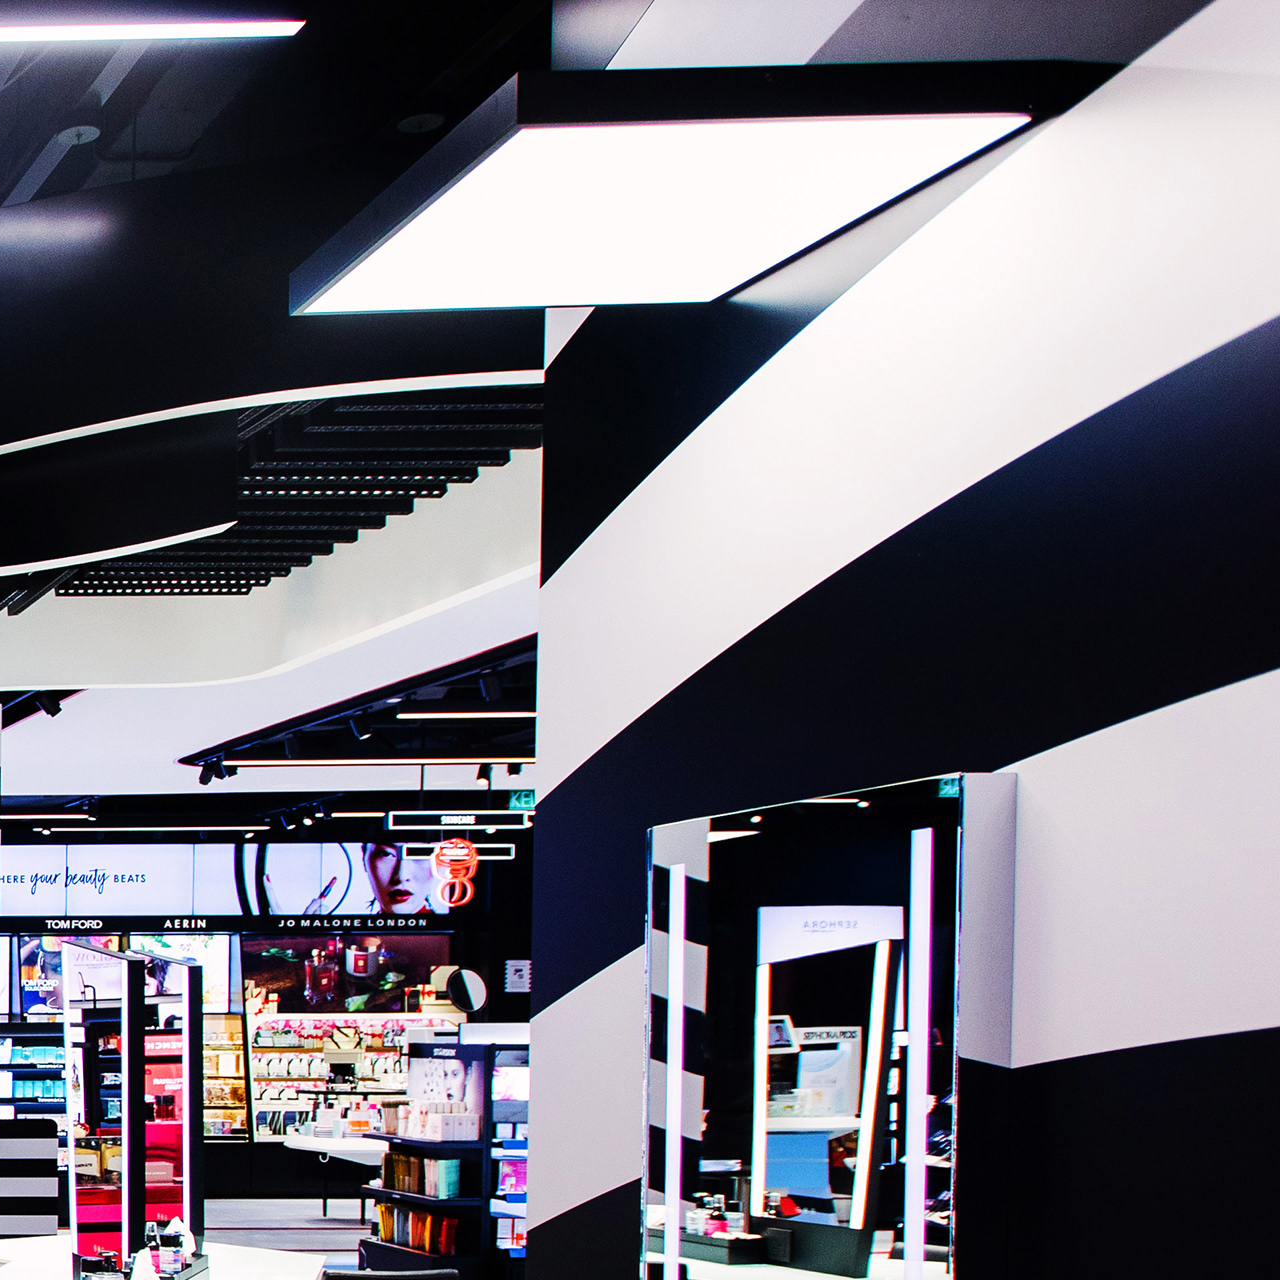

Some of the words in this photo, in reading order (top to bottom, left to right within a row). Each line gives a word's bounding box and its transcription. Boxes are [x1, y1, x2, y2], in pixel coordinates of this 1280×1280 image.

[30, 871, 61, 895] your
[64, 866, 110, 895] beauty
[114, 874, 146, 883] BEATS
[46, 919, 71, 929] TOM
[71, 919, 103, 929] FORD
[164, 919, 207, 929] AERIN
[278, 919, 296, 927] JO
[301, 919, 362, 927] MALONE
[367, 919, 427, 927] LONDON
